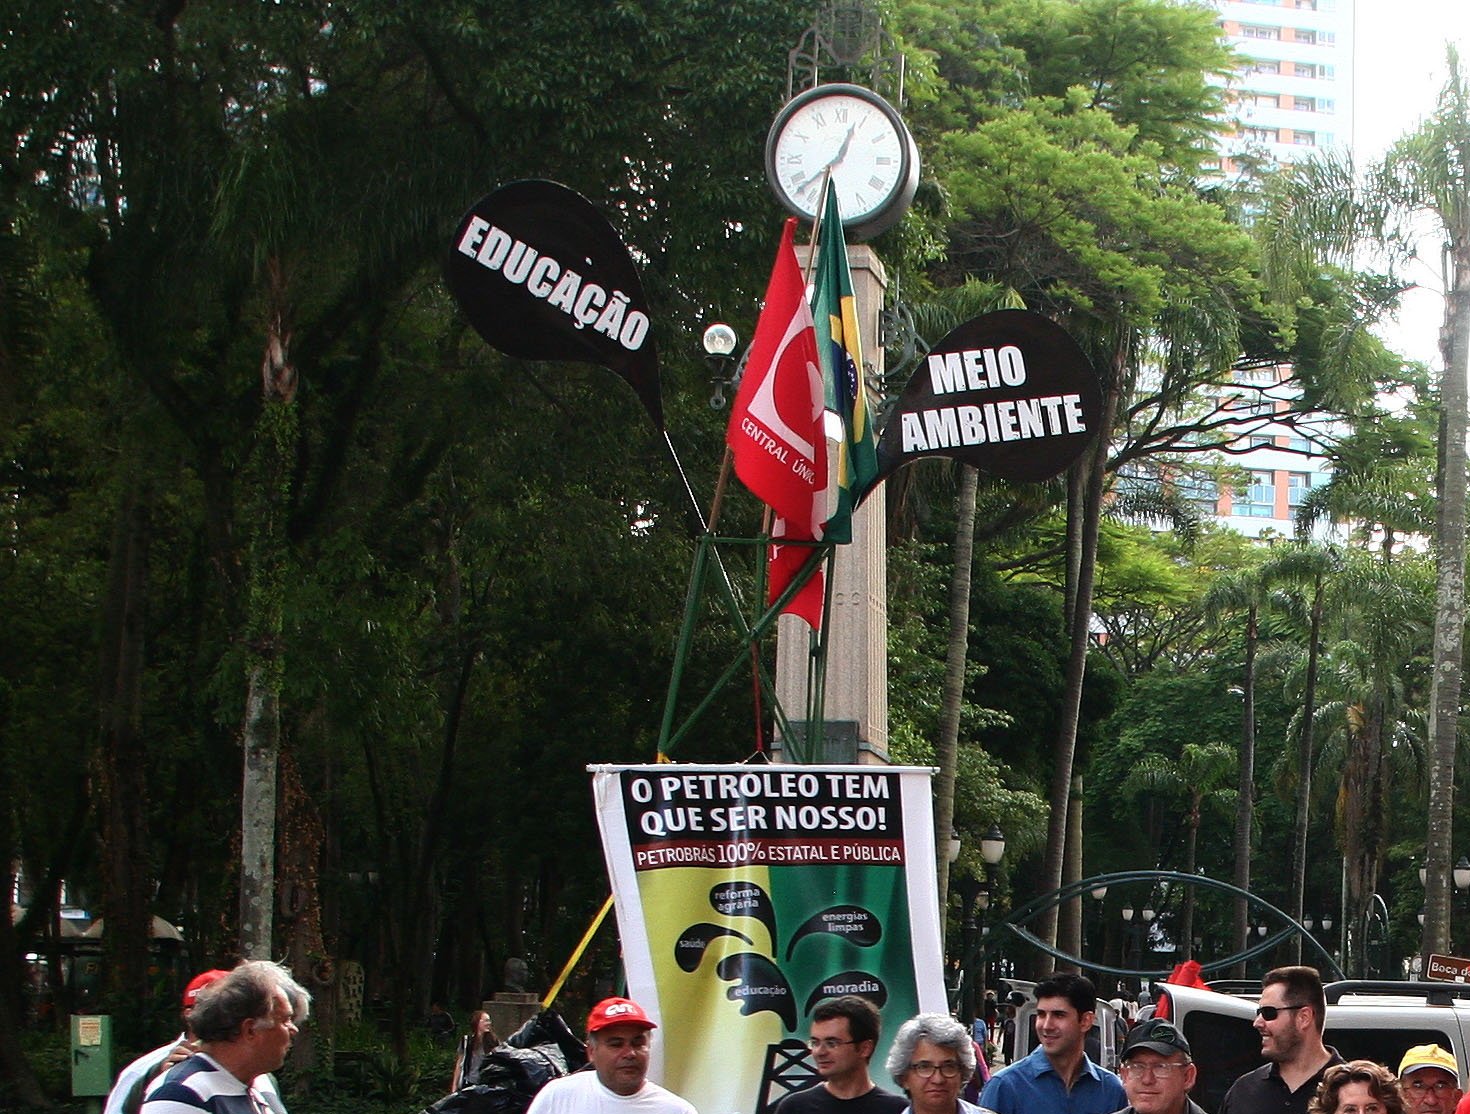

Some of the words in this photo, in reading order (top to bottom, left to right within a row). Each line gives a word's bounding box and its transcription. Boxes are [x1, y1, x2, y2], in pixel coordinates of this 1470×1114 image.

[457, 214, 650, 352] EDUCAÇÃO
[929, 345, 1026, 396] MEIO
[901, 394, 1087, 453] AMBIENTE
[741, 417, 788, 464] CENTRAL
[792, 458, 815, 484] ÚNIC
[631, 778, 652, 803] O
[826, 774, 890, 800] TEM
[640, 806, 704, 837] QUE
[711, 806, 767, 832] SER
[776, 805, 887, 832] NOSSO!
[717, 842, 767, 864] 100%
[769, 845, 829, 862] ESTATAL
[831, 845, 841, 861] E
[844, 842, 902, 862] PÚBLICA
[1431, 961, 1458, 975] Boca
[823, 981, 880, 995] moradia
